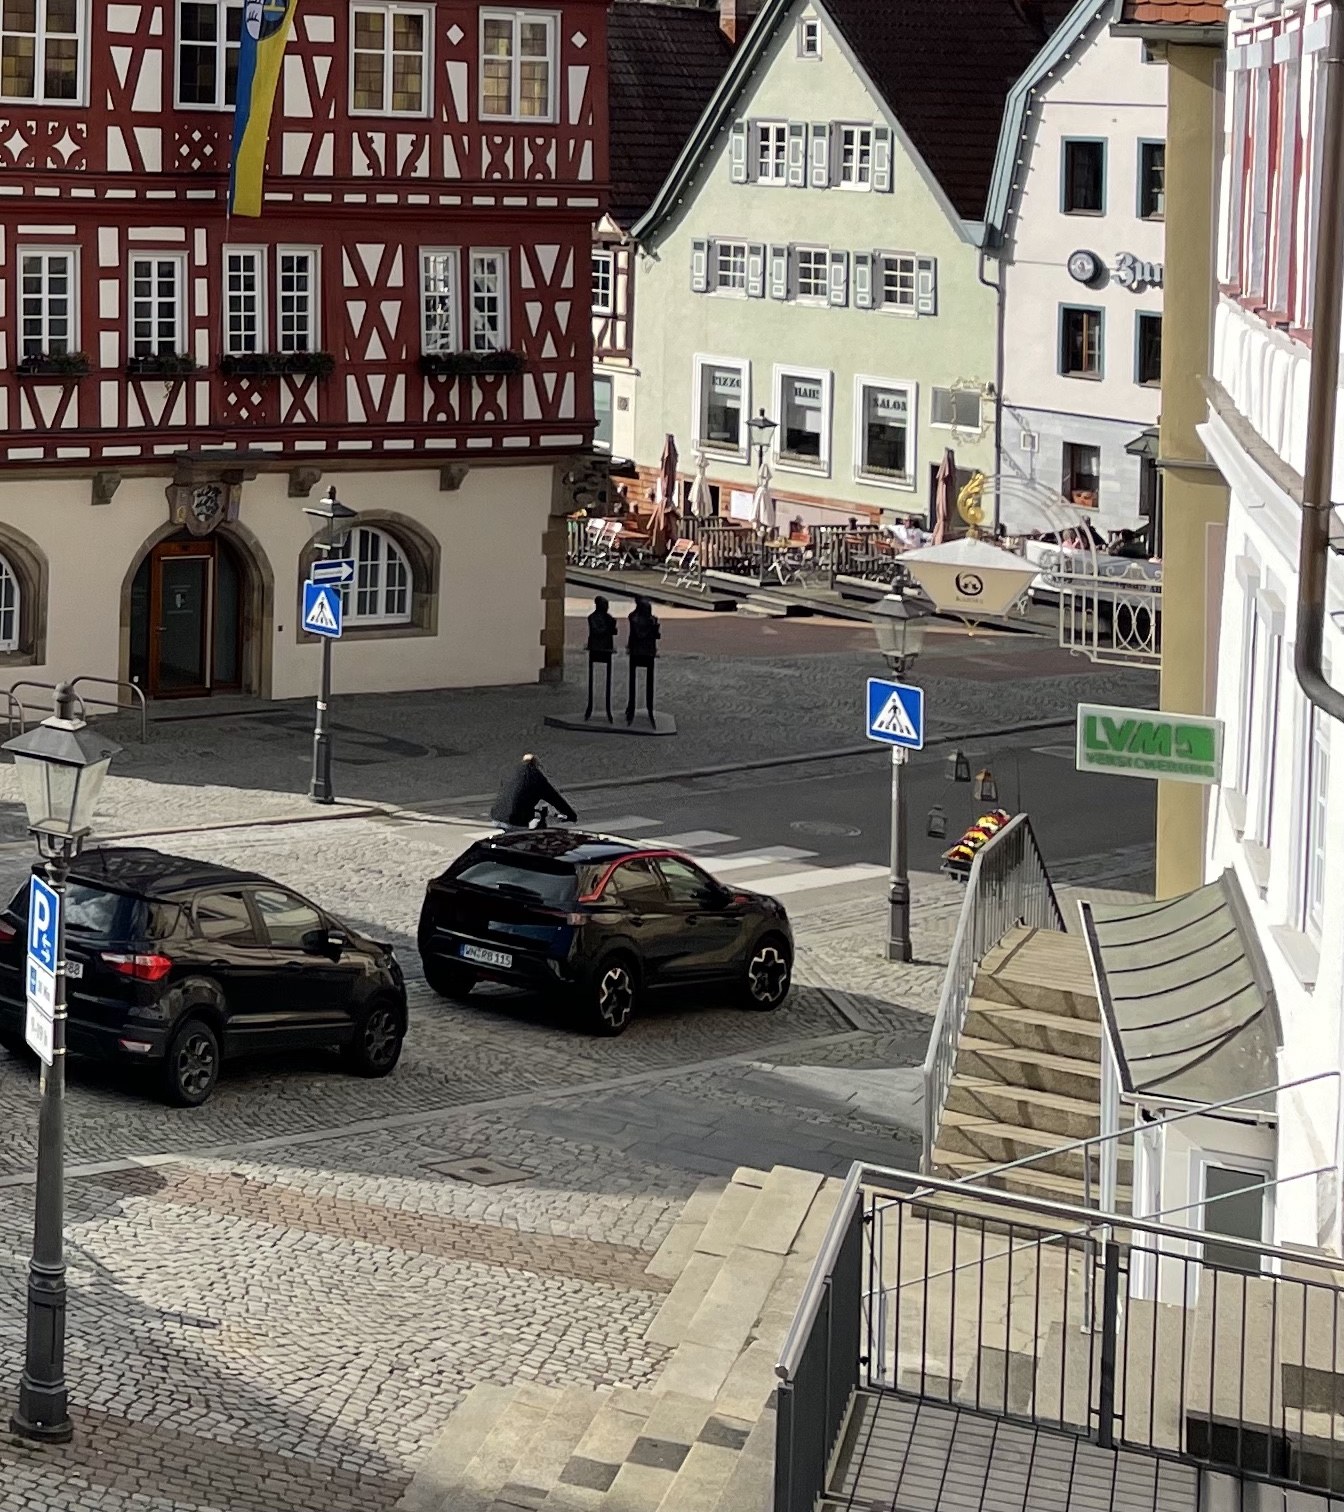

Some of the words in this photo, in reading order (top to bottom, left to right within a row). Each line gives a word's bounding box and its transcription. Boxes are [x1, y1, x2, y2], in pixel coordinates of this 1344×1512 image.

[1084, 715, 1172, 757] LVM
[33, 890, 50, 949] P
[494, 953, 511, 966] 115
